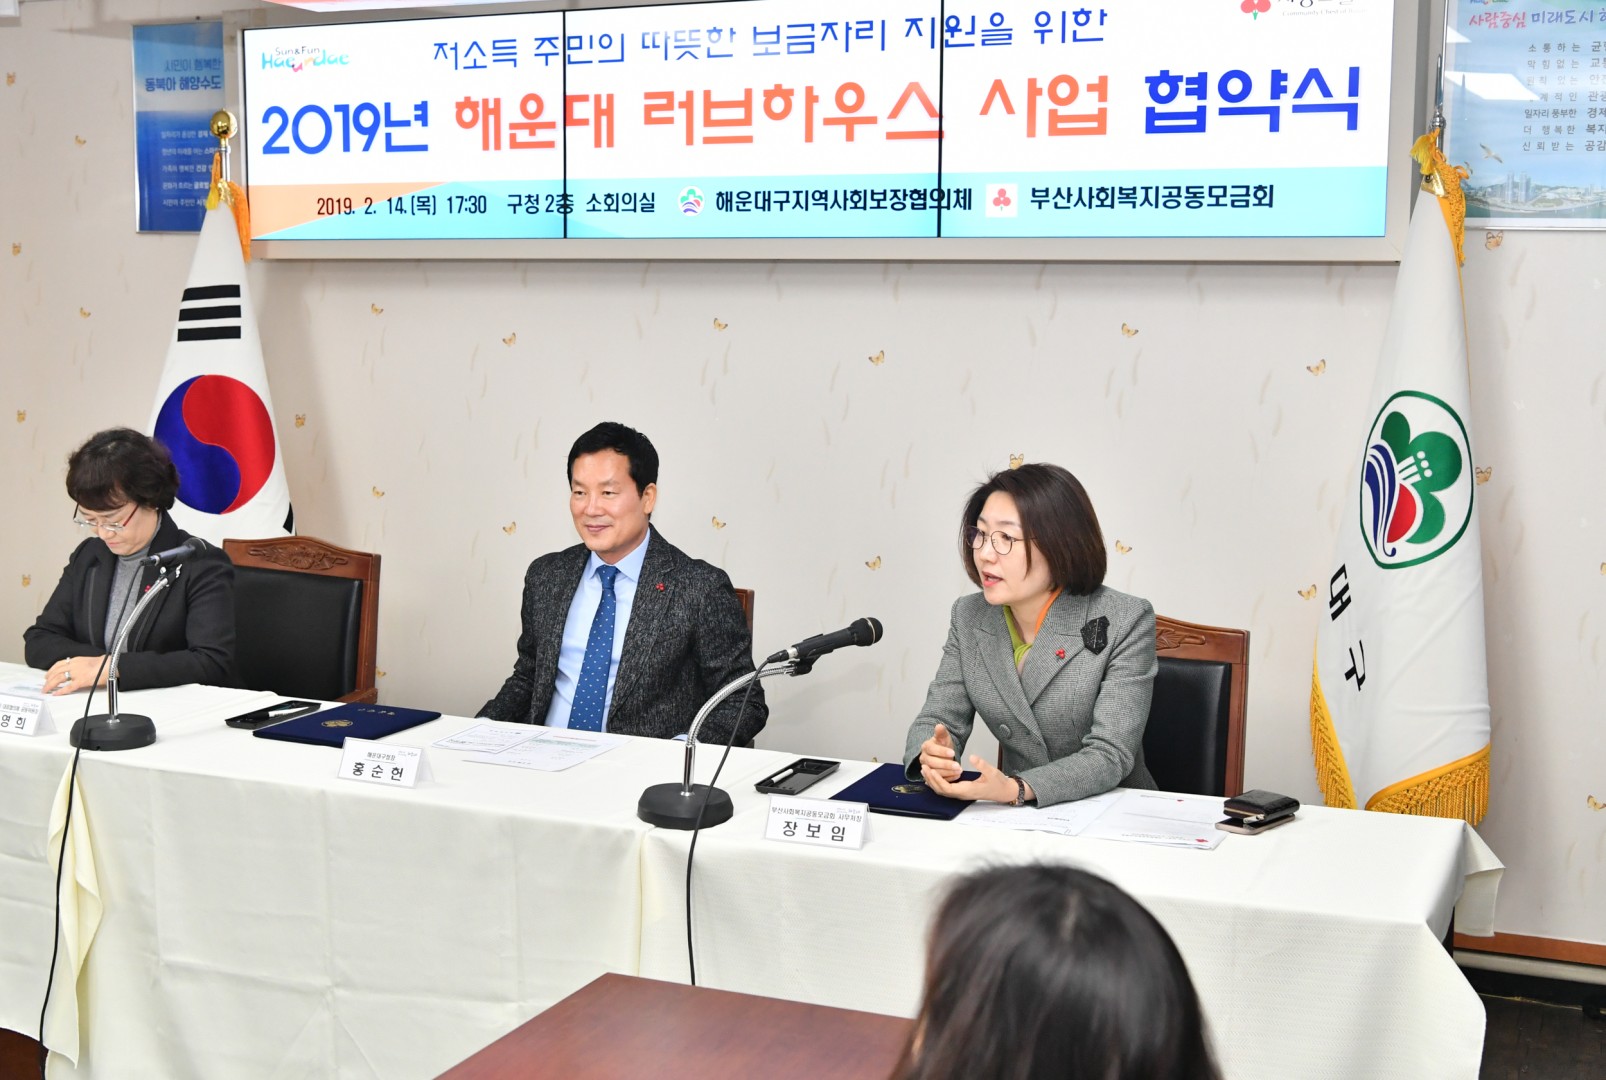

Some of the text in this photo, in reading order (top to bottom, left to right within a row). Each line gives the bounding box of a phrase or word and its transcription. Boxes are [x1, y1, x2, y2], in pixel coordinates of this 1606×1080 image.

[1468, 11, 1528, 29] 사람중심
[1531, 9, 1594, 24] 미래도시
[433, 7, 1108, 70] 저소득 주민의 따뜻한 보금자리 지원을 위한
[145, 75, 222, 92] 동북아 해양수도
[262, 66, 1361, 155] 2019년 해운대 러브하우스 사업 협약식
[1524, 108, 1550, 119] 일자리
[1584, 140, 1606, 152] 공감
[316, 198, 356, 216] 2019.
[364, 197, 378, 215] 2.
[386, 195, 437, 216] 14.(목)
[446, 195, 488, 215] 17:30
[586, 192, 656, 214] 소회의실
[715, 188, 973, 213] 해운대구지역사회보장협의체
[1030, 184, 1275, 210] 부산사회복지공동모금회
[771, 806, 836, 820] 부산사회복지공동모금회
